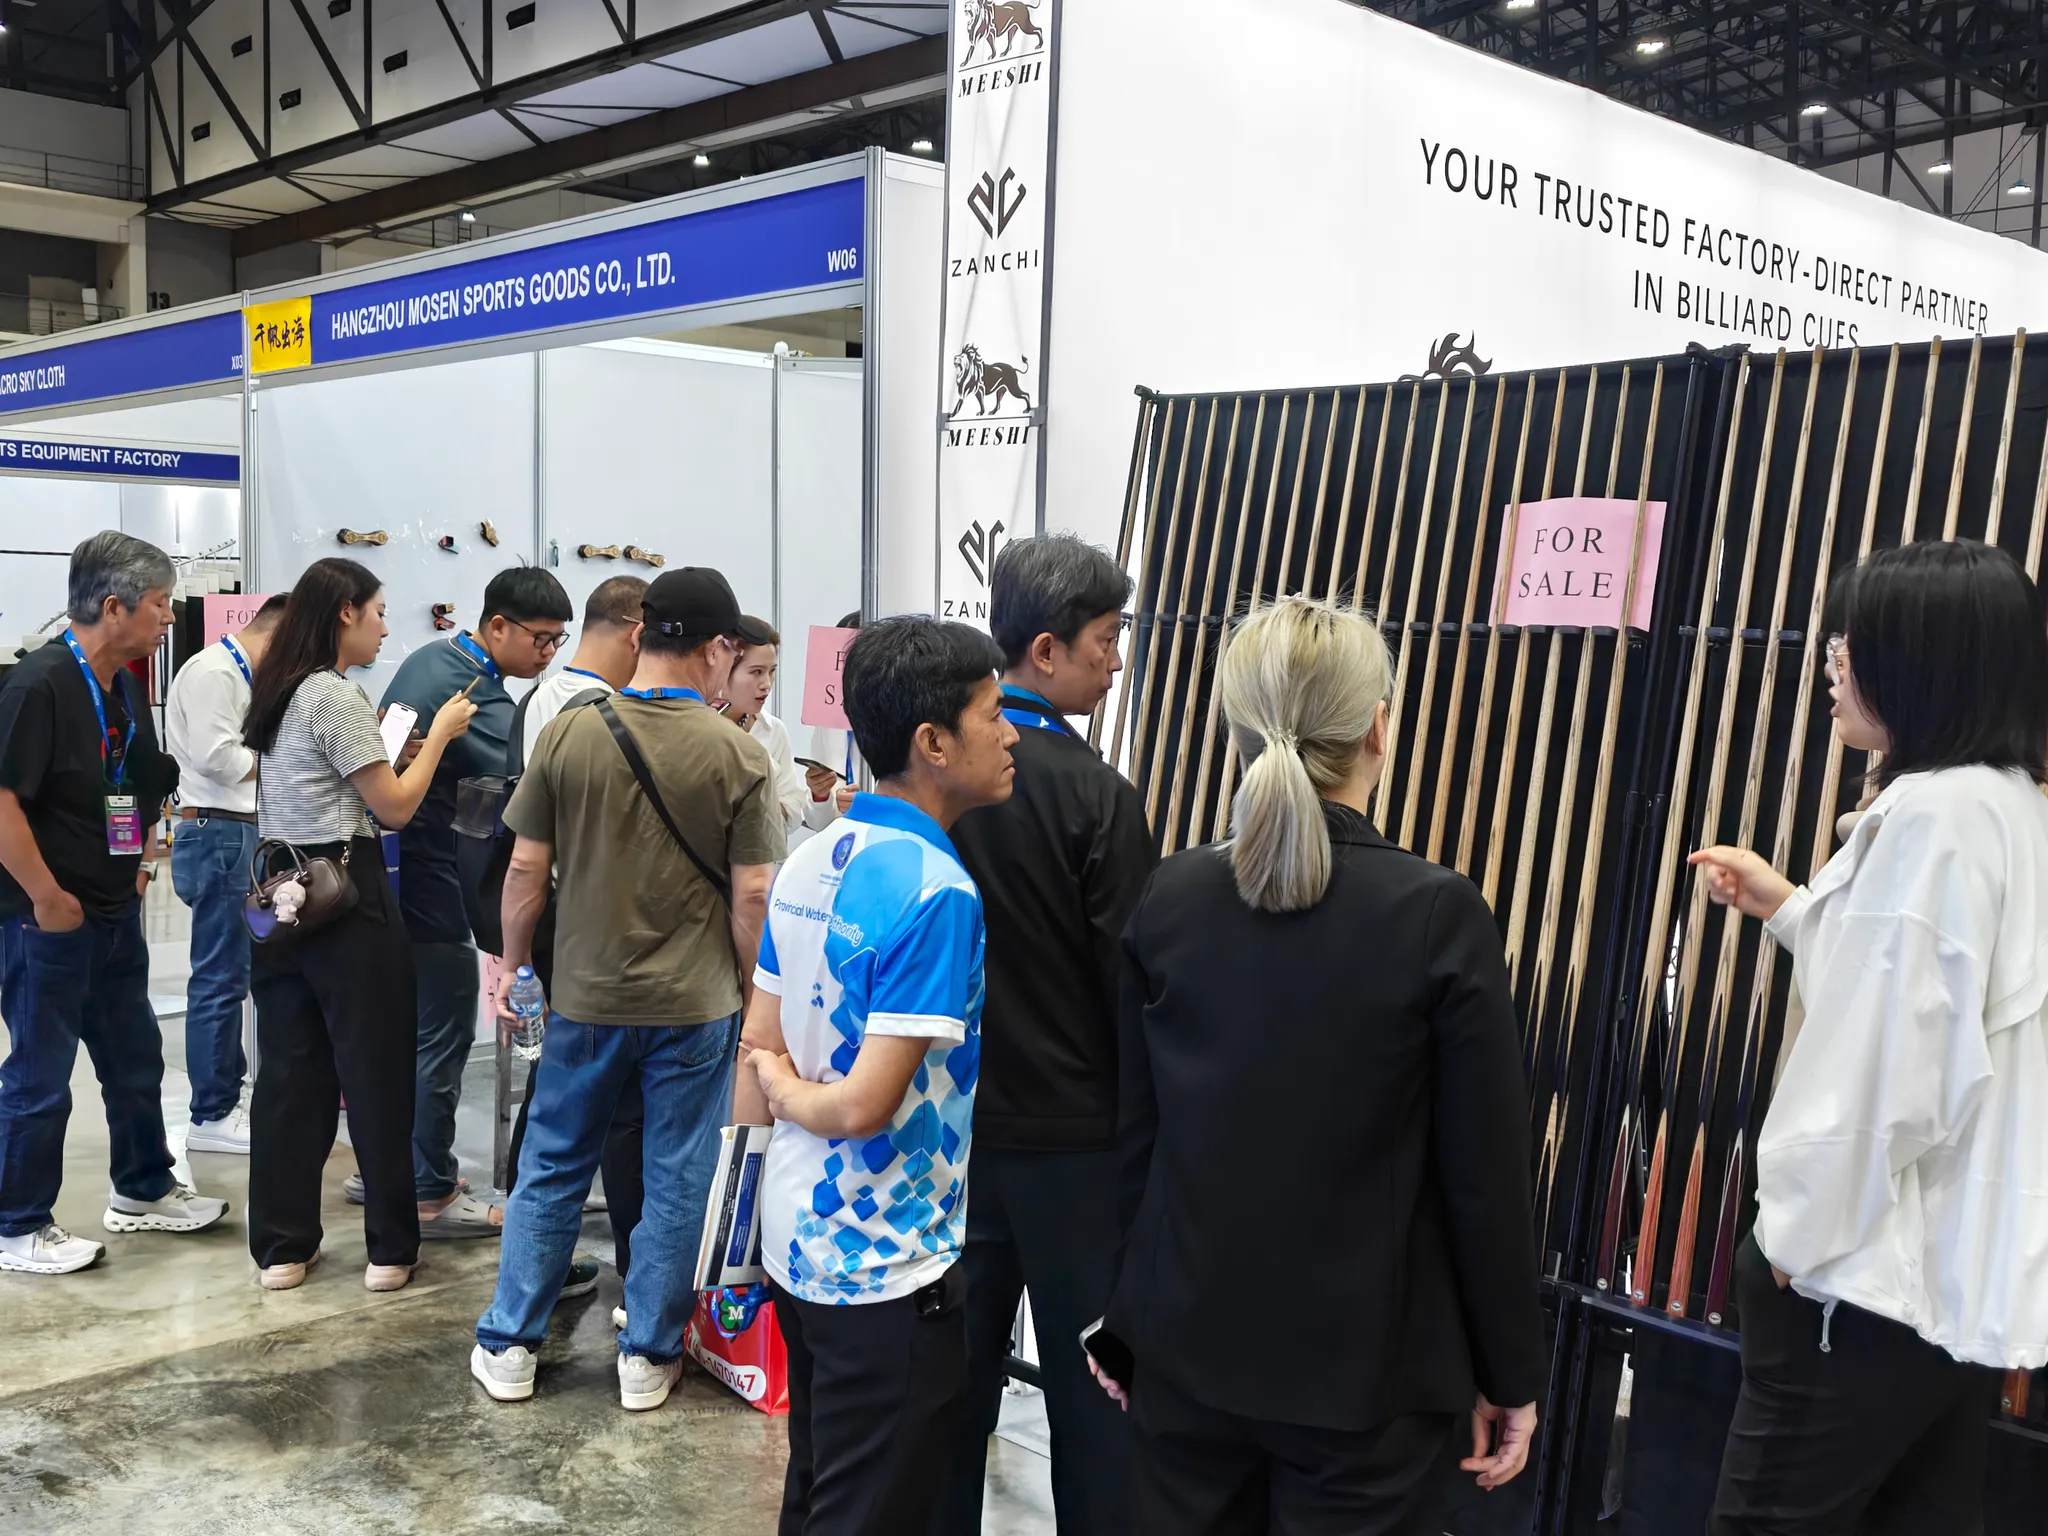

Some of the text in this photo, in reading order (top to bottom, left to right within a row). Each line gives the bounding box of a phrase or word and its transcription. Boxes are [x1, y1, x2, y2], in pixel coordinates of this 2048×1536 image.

[957, 61, 1042, 98] MEESHI
[1420, 138, 1988, 334] YOUR TRUSTED FACTORY-DIRECT PARTNER
[827, 247, 857, 273] W06
[951, 249, 1038, 278] ZANCHI
[147, 292, 171, 310] 13
[331, 251, 676, 341] HANGZHOU MOSEN SPORTS GOODS CO., LTD.
[1633, 269, 1663, 314] IN
[1677, 280, 1792, 342] BILLIARD
[0, 364, 66, 396] CRO SKY CLOTH
[946, 425, 1031, 448] MEESHI
[21, 443, 111, 463] EQUIPMENT
[114, 450, 181, 468] FACTORY
[1532, 526, 1605, 555] FOR
[1518, 570, 1613, 599] SALE
[943, 600, 987, 619] ZAN
[728, 1305, 745, 1321] M
